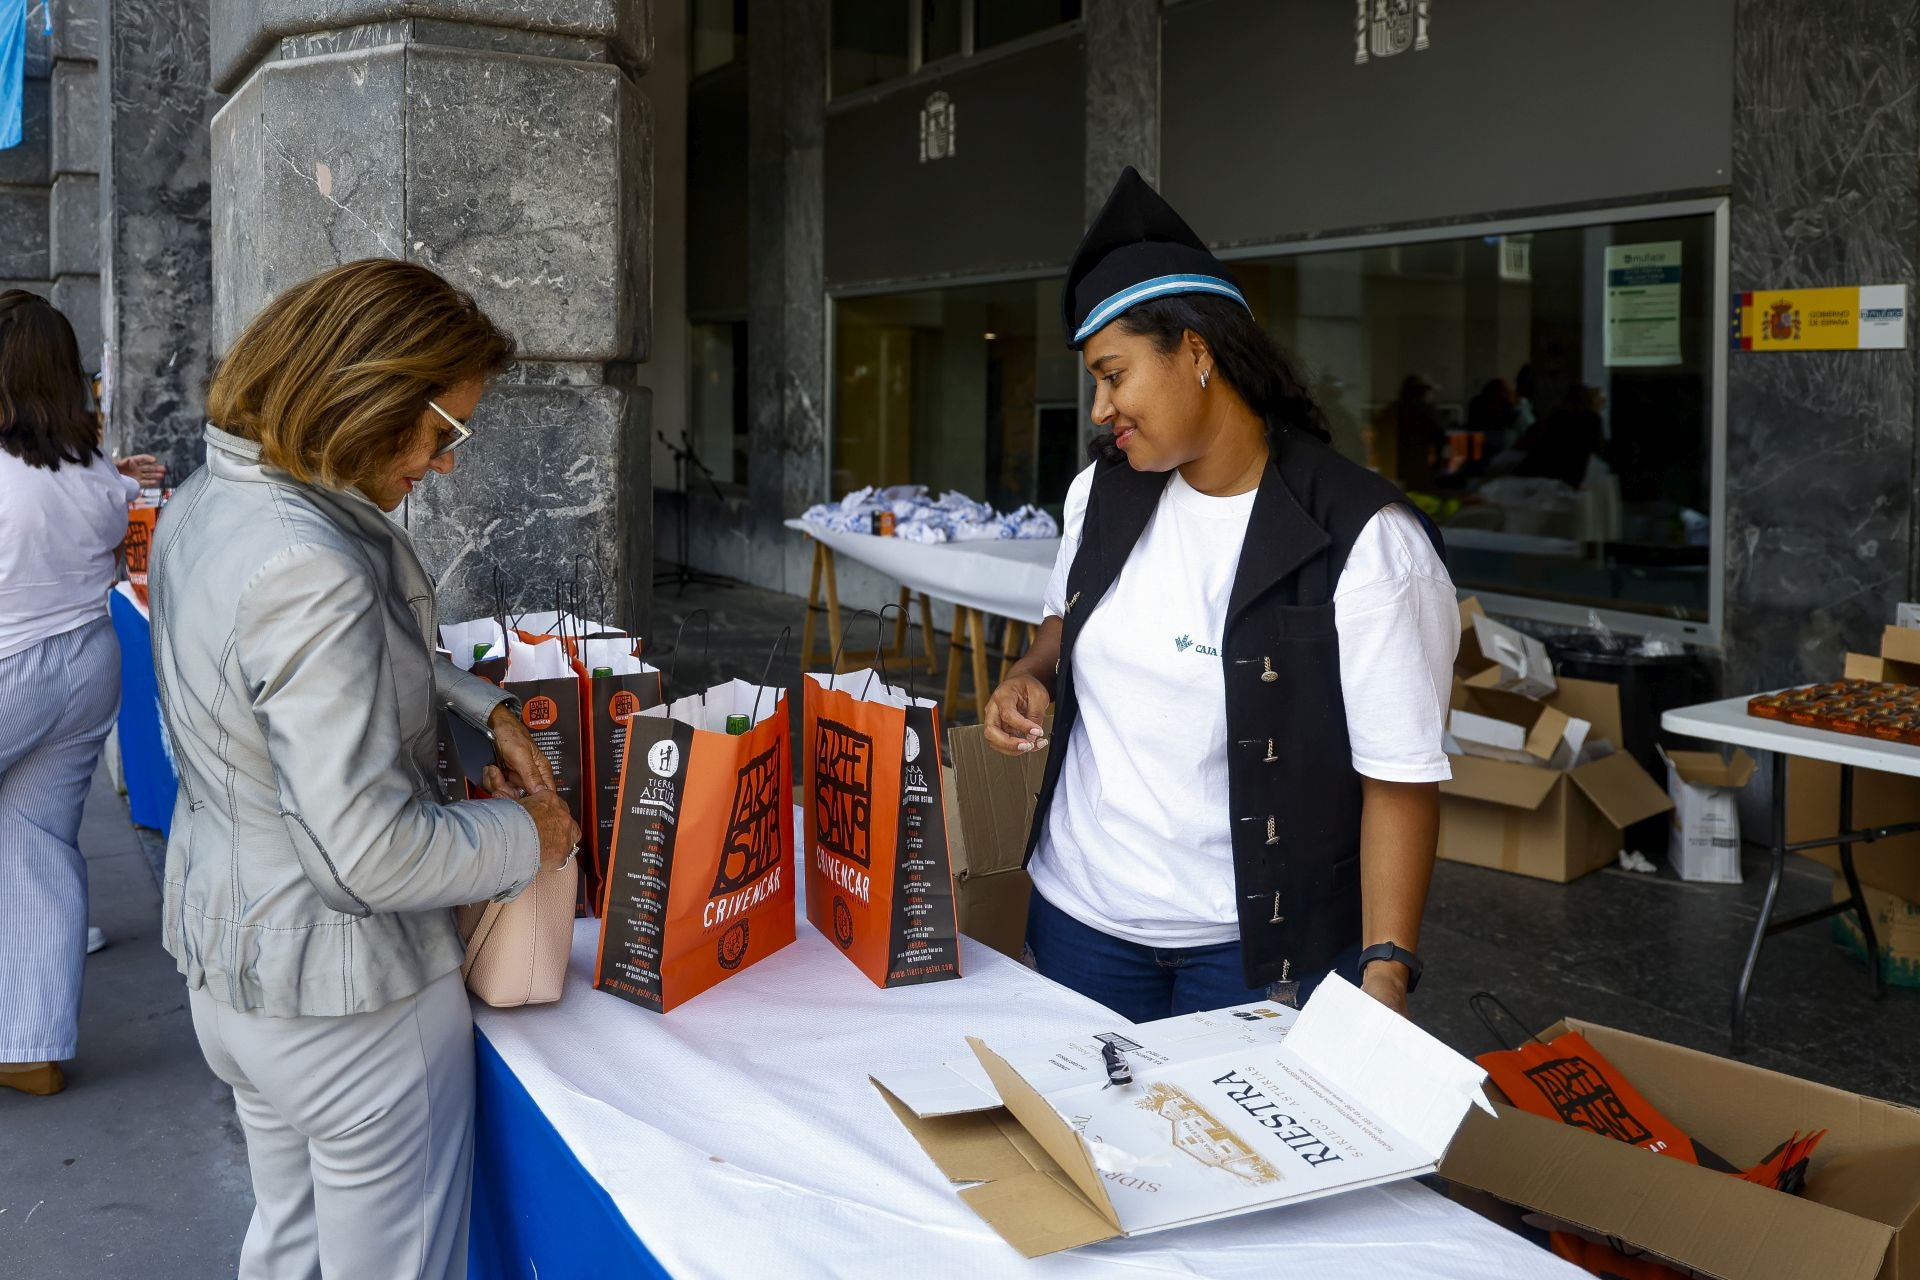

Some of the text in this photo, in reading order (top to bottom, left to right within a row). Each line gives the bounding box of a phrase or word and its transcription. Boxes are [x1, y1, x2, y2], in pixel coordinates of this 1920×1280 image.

[1196, 644, 1218, 656] CAJA
[640, 786, 674, 806] ASTUR
[648, 778, 674, 792] TIERRA
[816, 846, 870, 904] CRIVENCAR
[703, 866, 782, 928] CRIVENCAR
[891, 963, 954, 979] www.tierra-astur.com
[1212, 1069, 1344, 1168] RIESTRA
[1243, 1064, 1363, 1159] SARIEGO ASTURIAS
[1098, 1169, 1162, 1193] SIDR
